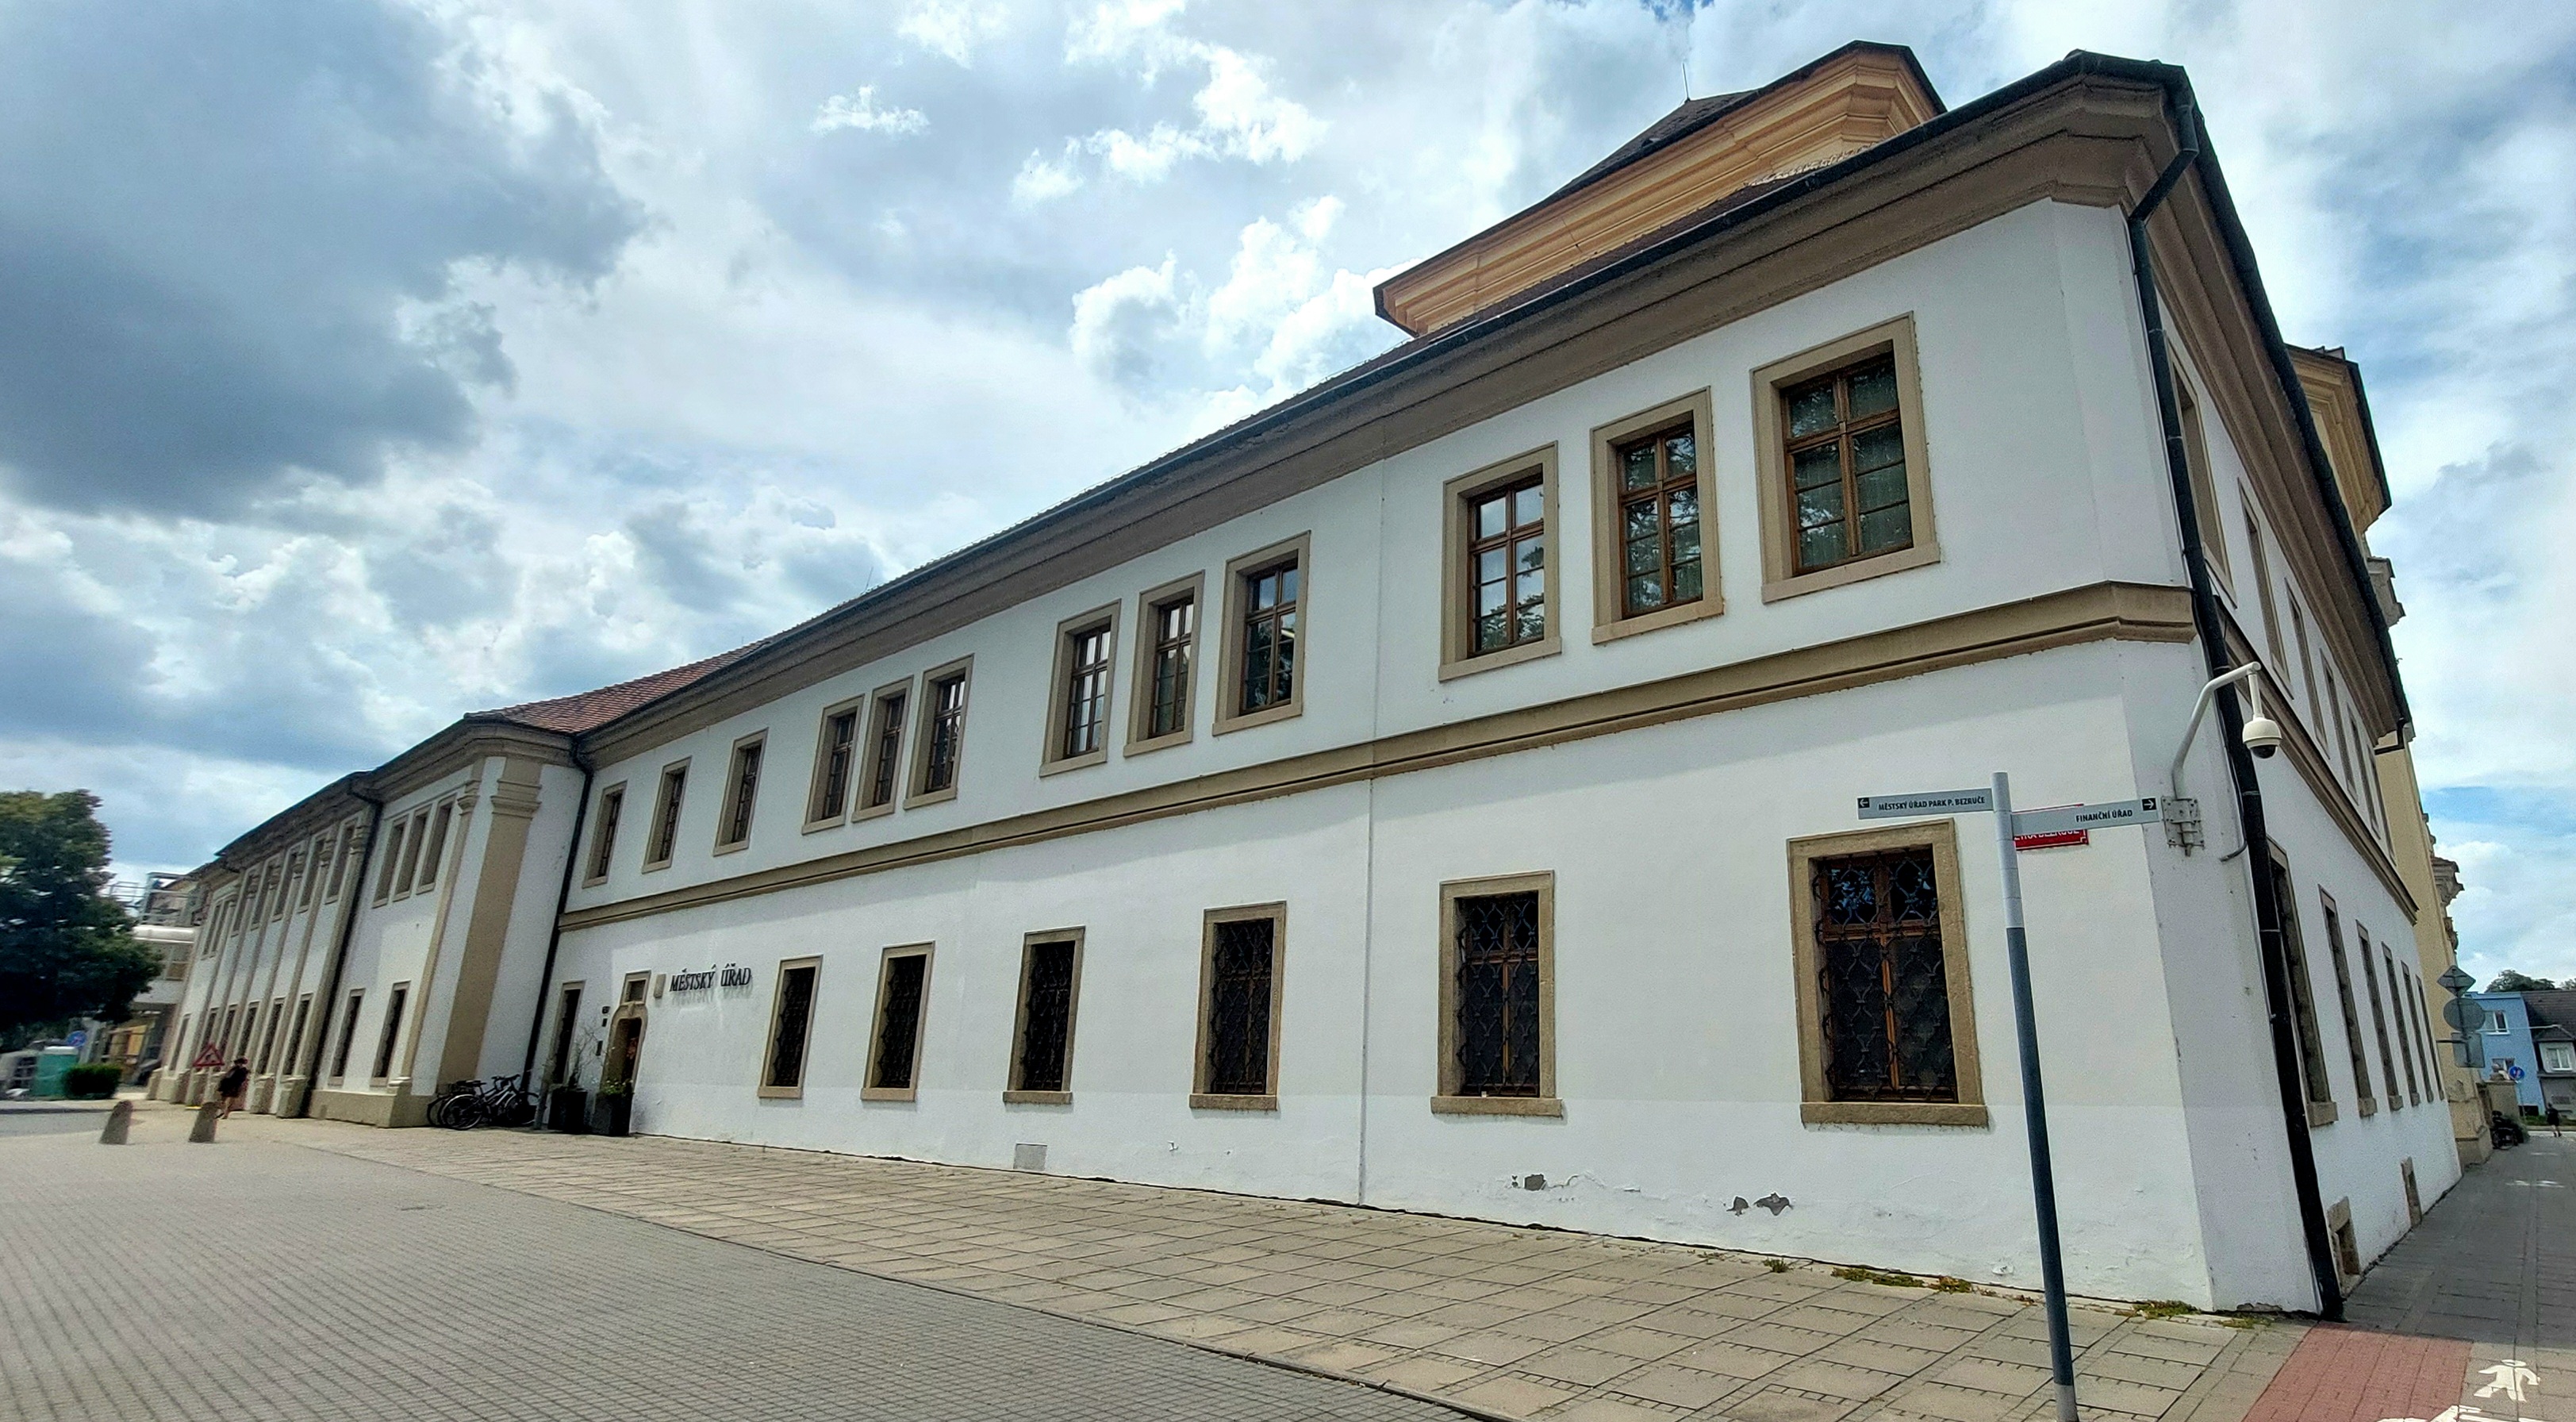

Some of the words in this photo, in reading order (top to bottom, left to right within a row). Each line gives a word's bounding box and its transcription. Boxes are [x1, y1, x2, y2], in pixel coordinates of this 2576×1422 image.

[1878, 801, 1907, 811] MĚSTSKÝ
[1908, 800, 1928, 809] ÚŘAD
[1955, 796, 1985, 805] BEZRUČE
[2075, 811, 2111, 823] FINANČNÍ
[2112, 809, 2133, 819] ÚŘAD
[669, 963, 716, 992] MĚSTSKÝ
[720, 963, 751, 986] ÚŘAD
